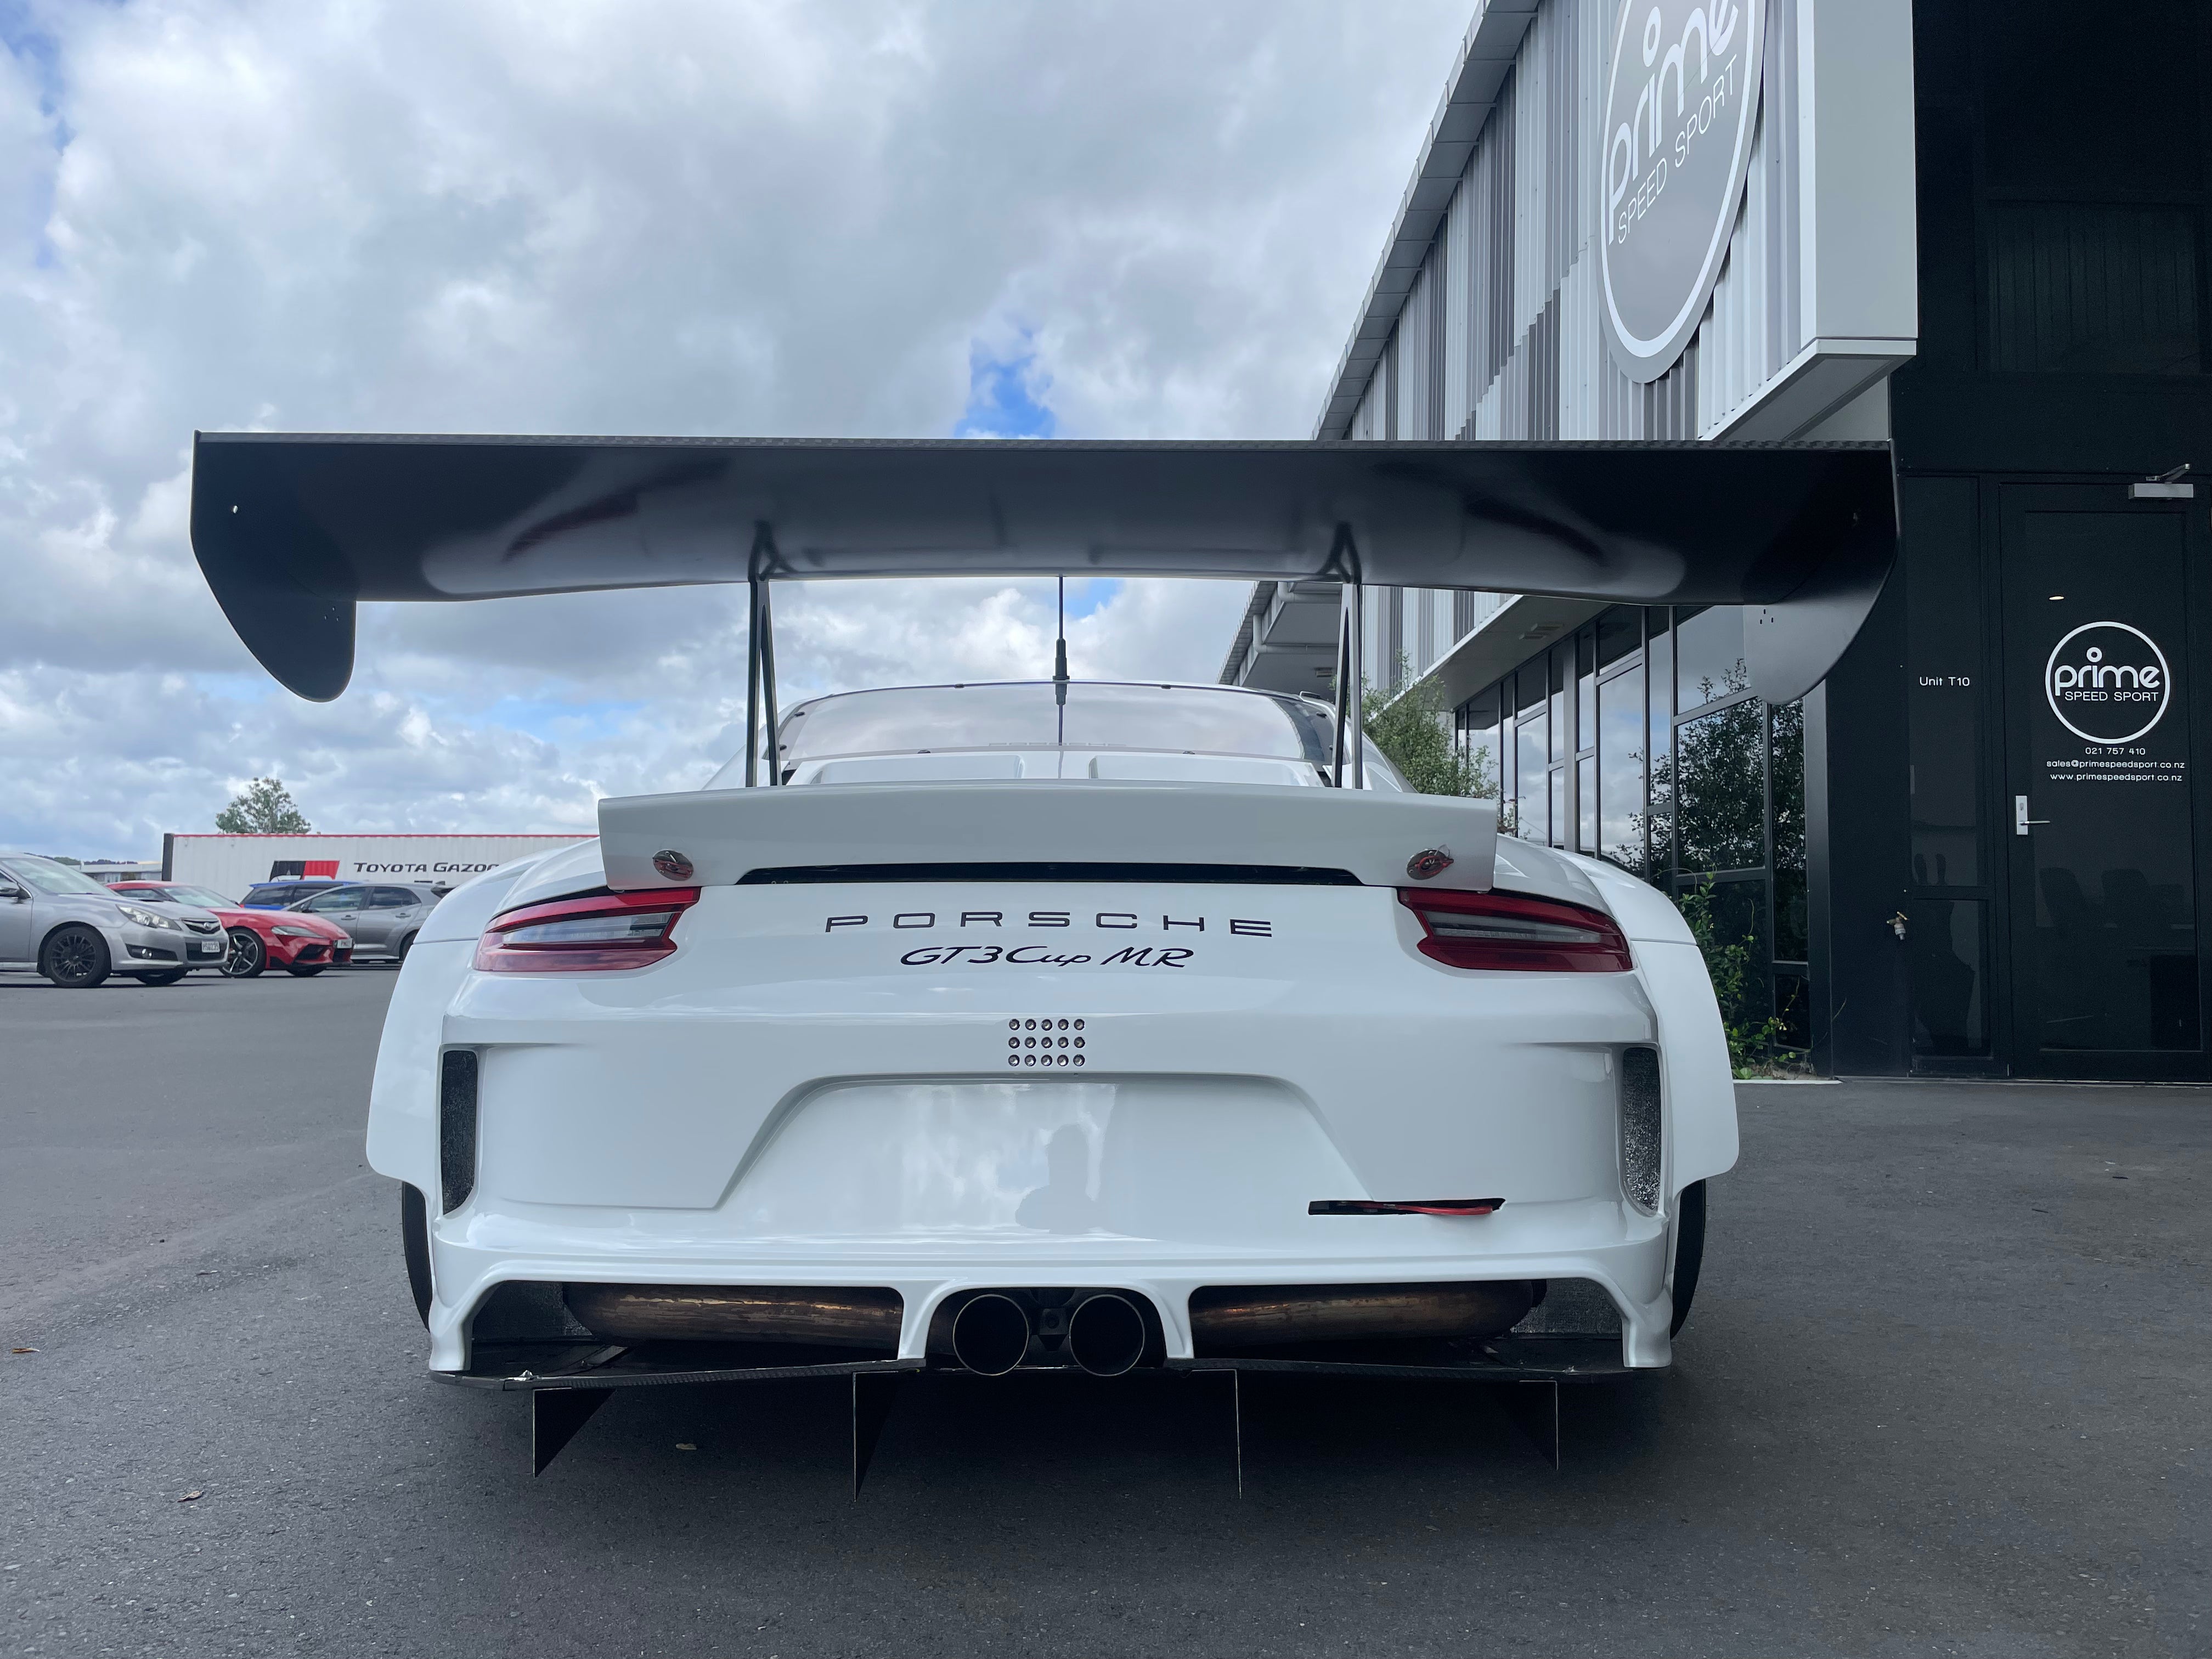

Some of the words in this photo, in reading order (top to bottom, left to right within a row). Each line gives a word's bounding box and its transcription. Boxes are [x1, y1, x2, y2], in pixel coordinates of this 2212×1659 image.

[1609, 0, 1738, 245] prime
[1618, 157, 1667, 244] SPEED
[1675, 54, 1737, 168] SPORT
[2054, 647, 2160, 696] prime
[1920, 676, 1943, 686] Unit
[1948, 677, 1970, 687] T10
[2064, 691, 2108, 702] SPEED
[2114, 691, 2159, 702] SPORT
[2046, 760, 2185, 769] sales@primespeedsport.co.nz
[2050, 772, 2182, 782] www.primespeedsport.co.nz
[354, 862, 427, 873] TOYOTA
[825, 911, 1272, 937] PORSCHE
[1099, 946, 1195, 968] MR
